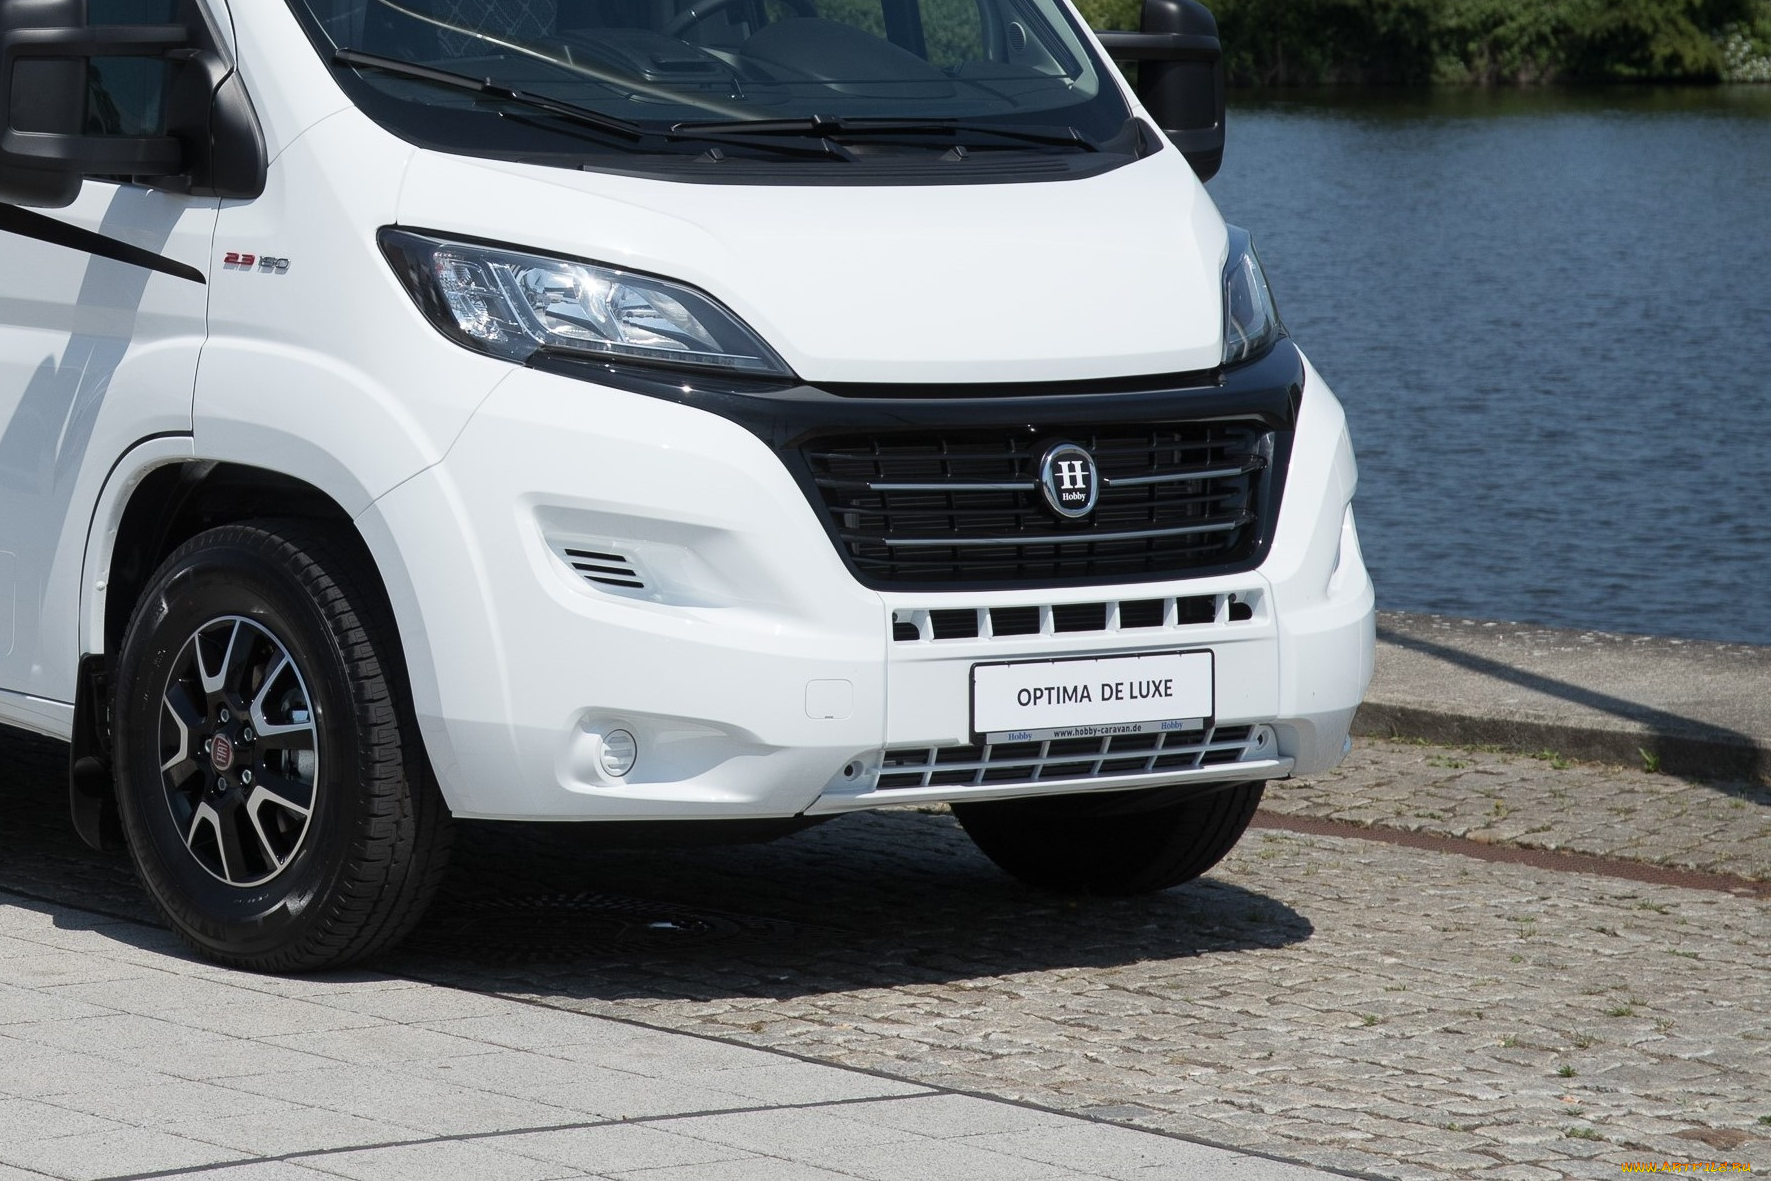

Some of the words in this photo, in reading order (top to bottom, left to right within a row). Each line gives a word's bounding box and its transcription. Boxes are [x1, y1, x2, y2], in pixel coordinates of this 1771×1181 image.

[1062, 492, 1087, 502] Hobby
[1017, 684, 1092, 707] OPTIMA
[1101, 682, 1124, 701] DE
[1130, 679, 1173, 700] LUXE
[1008, 732, 1033, 741] Hobby
[1053, 724, 1142, 738] www.hobby-caravan.de
[1161, 721, 1184, 730] Hobby
[217, 739, 228, 763] FIAT
